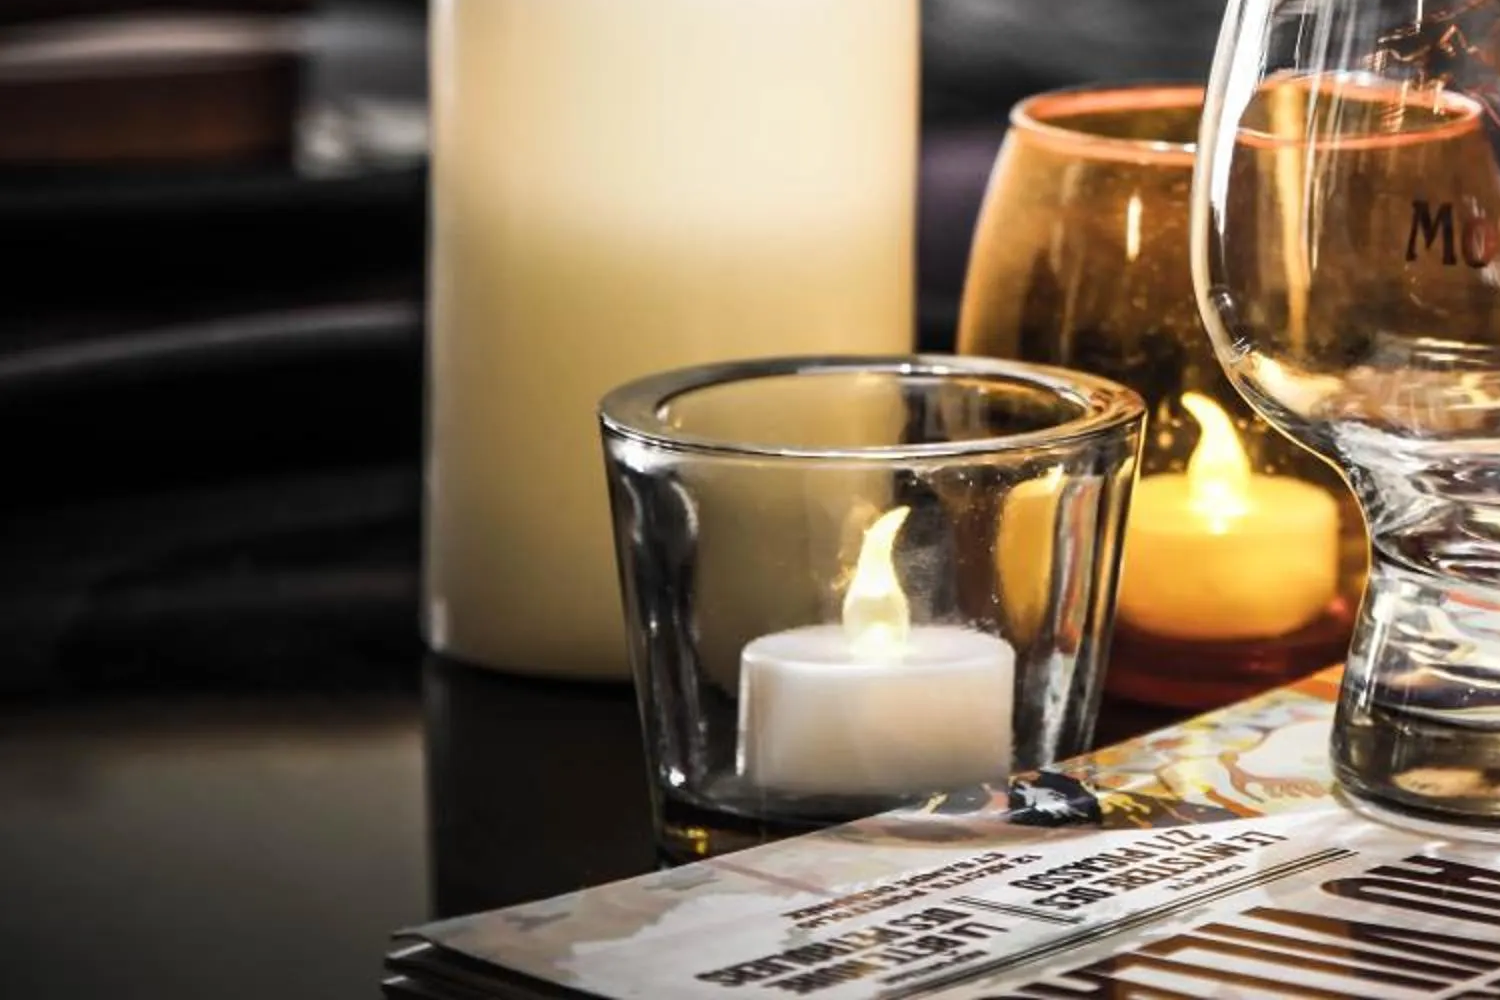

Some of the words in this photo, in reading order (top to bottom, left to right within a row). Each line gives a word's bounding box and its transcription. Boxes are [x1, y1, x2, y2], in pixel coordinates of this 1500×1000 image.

[1132, 829, 1212, 852] 271
[1225, 831, 1288, 847] LE
[1008, 845, 1160, 891] PICASSO
[1011, 853, 1043, 865] 12
[1091, 841, 1253, 892] MYSTÈRE
[1031, 885, 1116, 910] DES
[886, 907, 974, 931] DES
[941, 922, 1009, 939] LA
